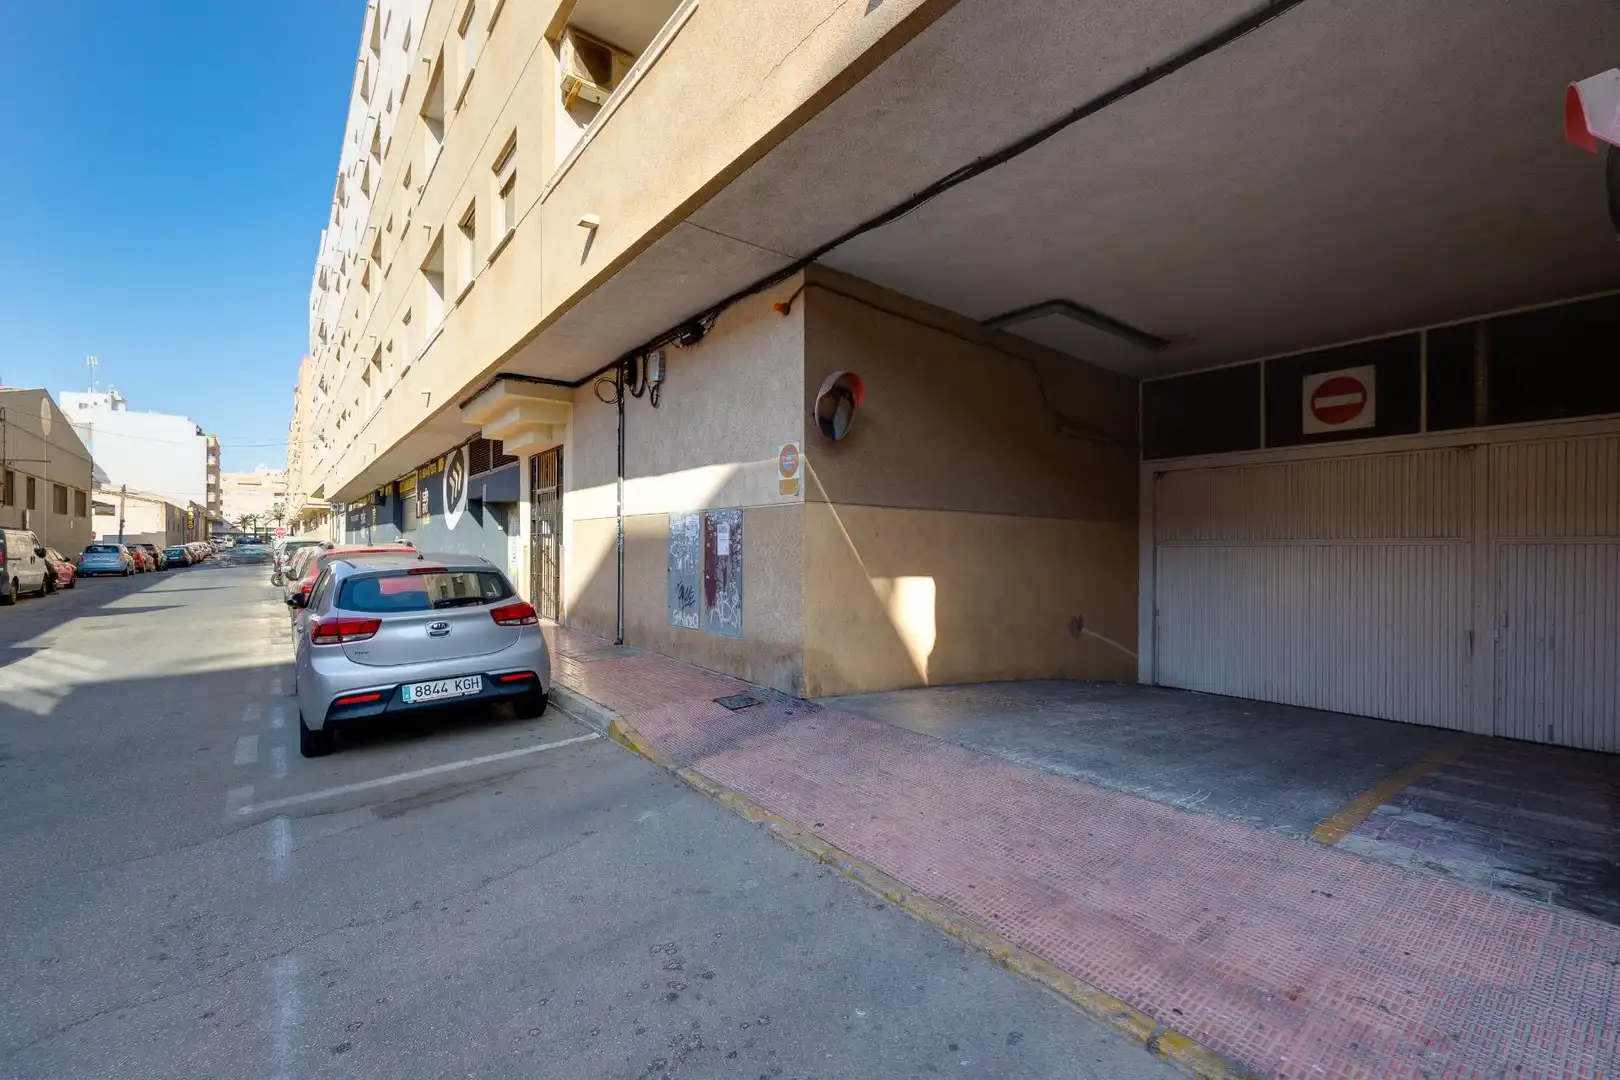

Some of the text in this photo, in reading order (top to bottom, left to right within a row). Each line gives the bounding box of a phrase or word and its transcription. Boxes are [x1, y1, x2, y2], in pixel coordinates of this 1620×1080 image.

[433, 622, 446, 630] KIA
[415, 682, 448, 697] 8844
[454, 677, 480, 692] KGH
